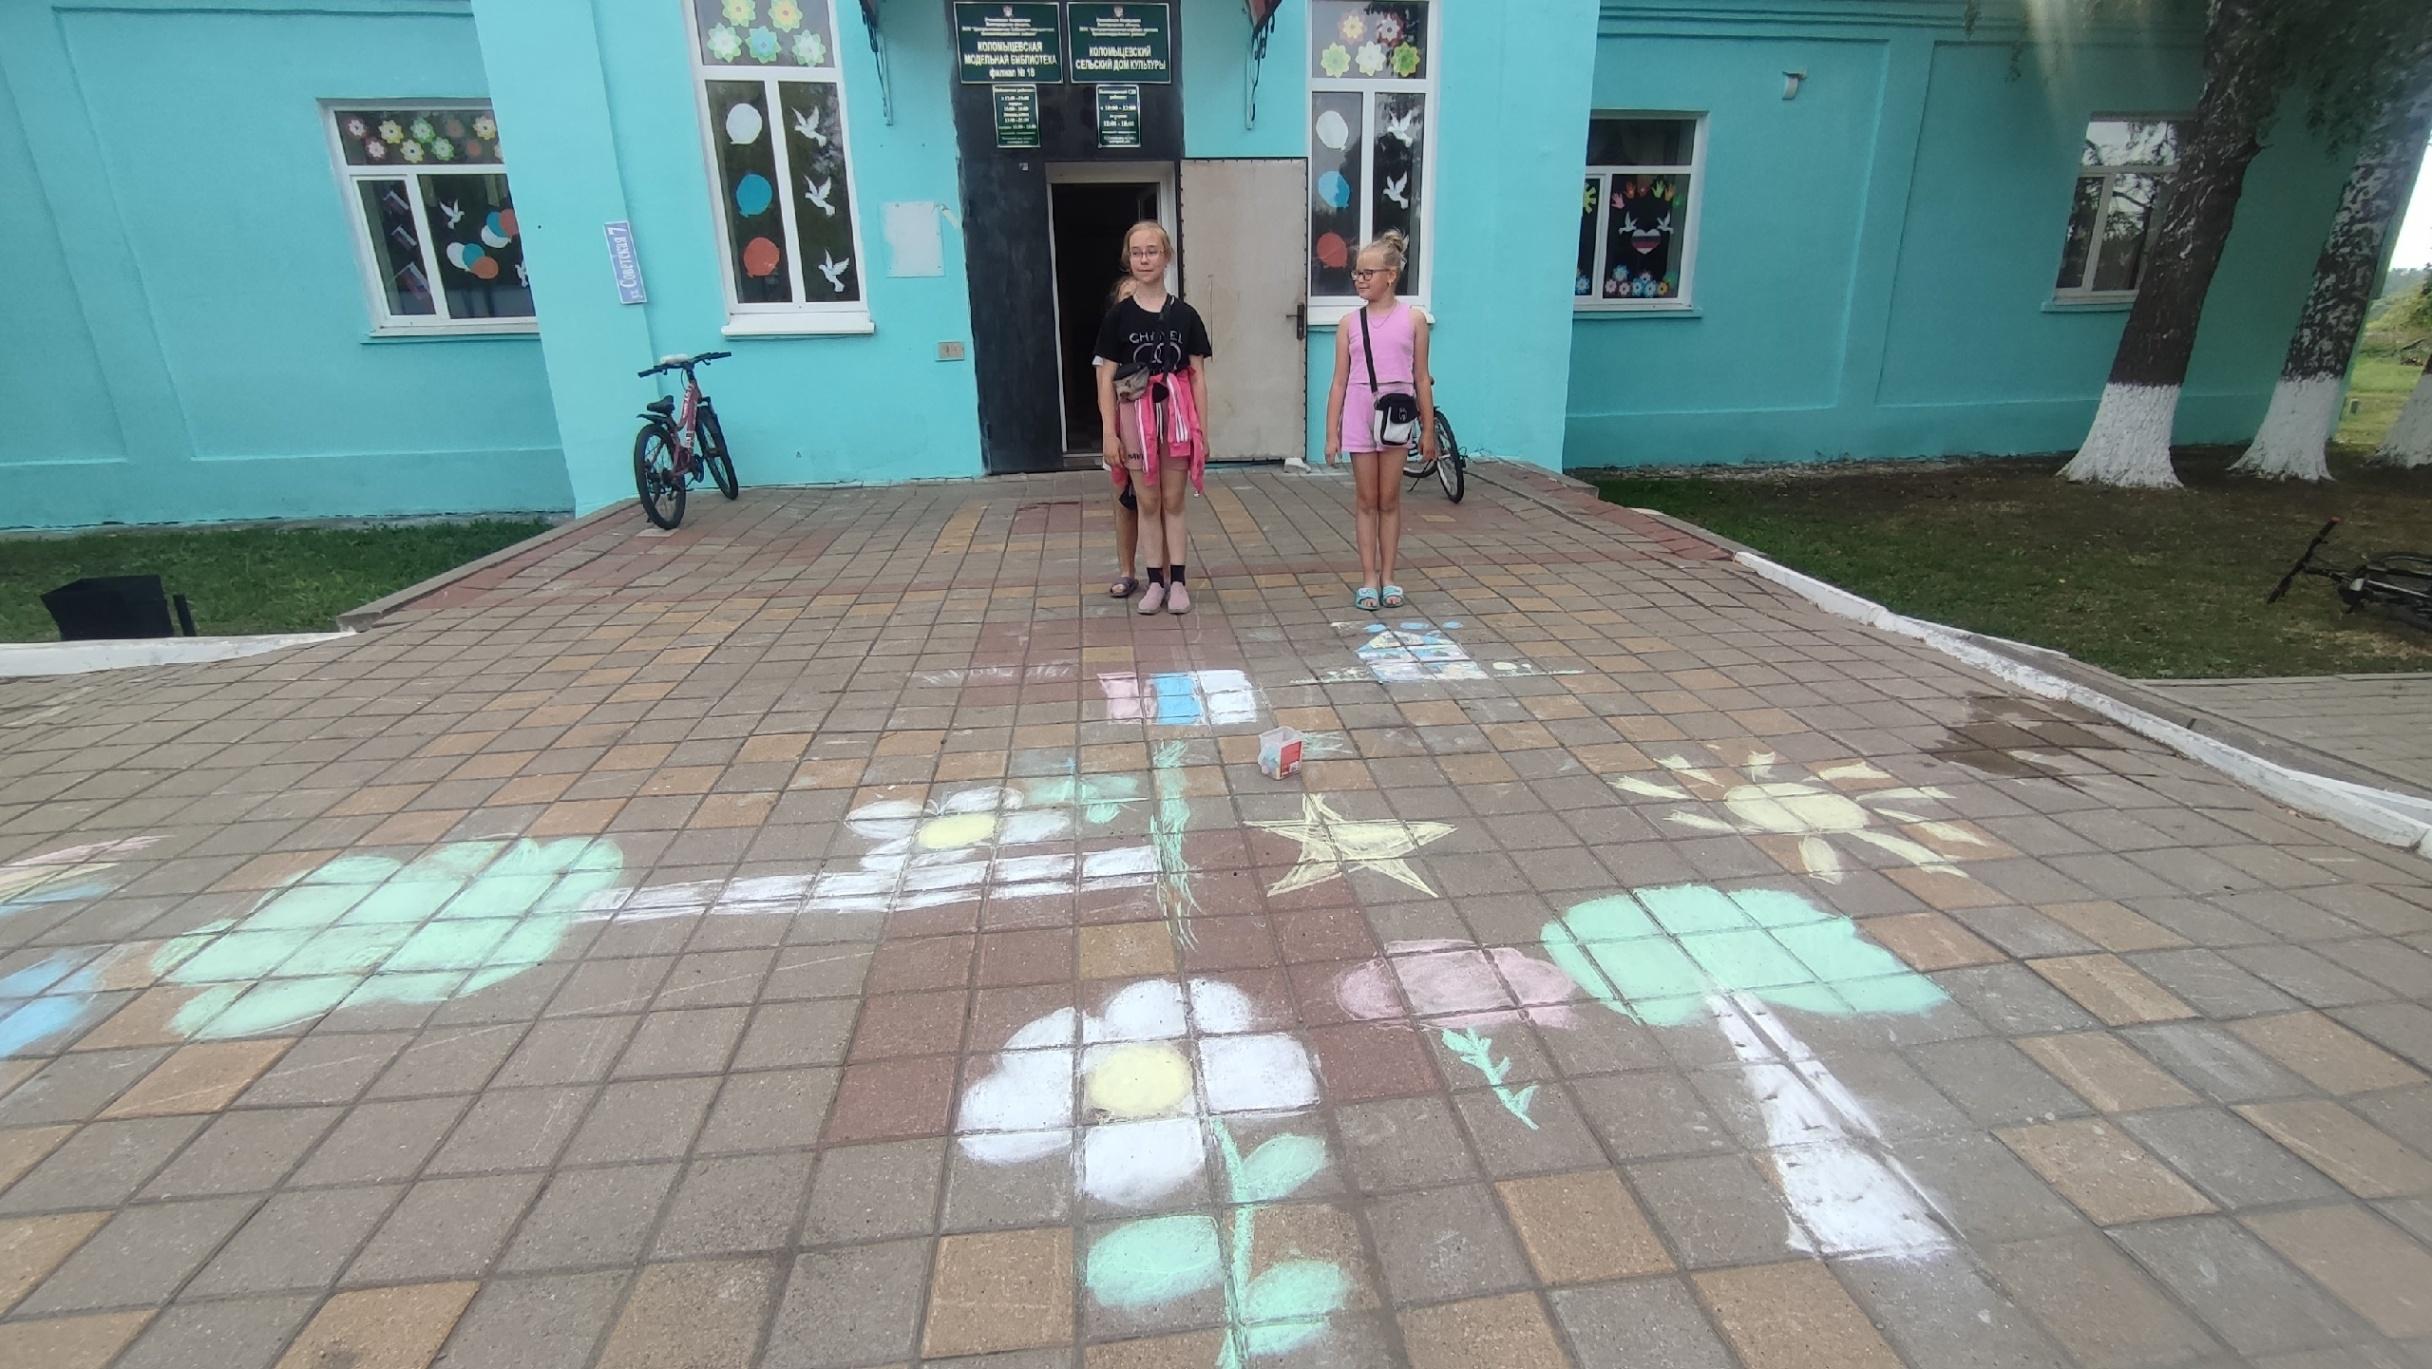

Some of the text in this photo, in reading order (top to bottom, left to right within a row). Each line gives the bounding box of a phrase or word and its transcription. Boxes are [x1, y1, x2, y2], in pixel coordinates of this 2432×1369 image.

[1089, 45, 1152, 58] КОЛОМЫЦЕВСКИЙ
[964, 53, 1058, 66] МОДЕЛЬНАЯ БИБЛИОТЕКА
[1075, 58, 1166, 71] СЕЛЬСКИЙ ДОМ КУЛЬТУРЫ
[989, 67, 1017, 79] филиал
[606, 227, 628, 236] 7
[614, 236, 638, 288] Советская
[1128, 329, 1183, 344] CHEL
